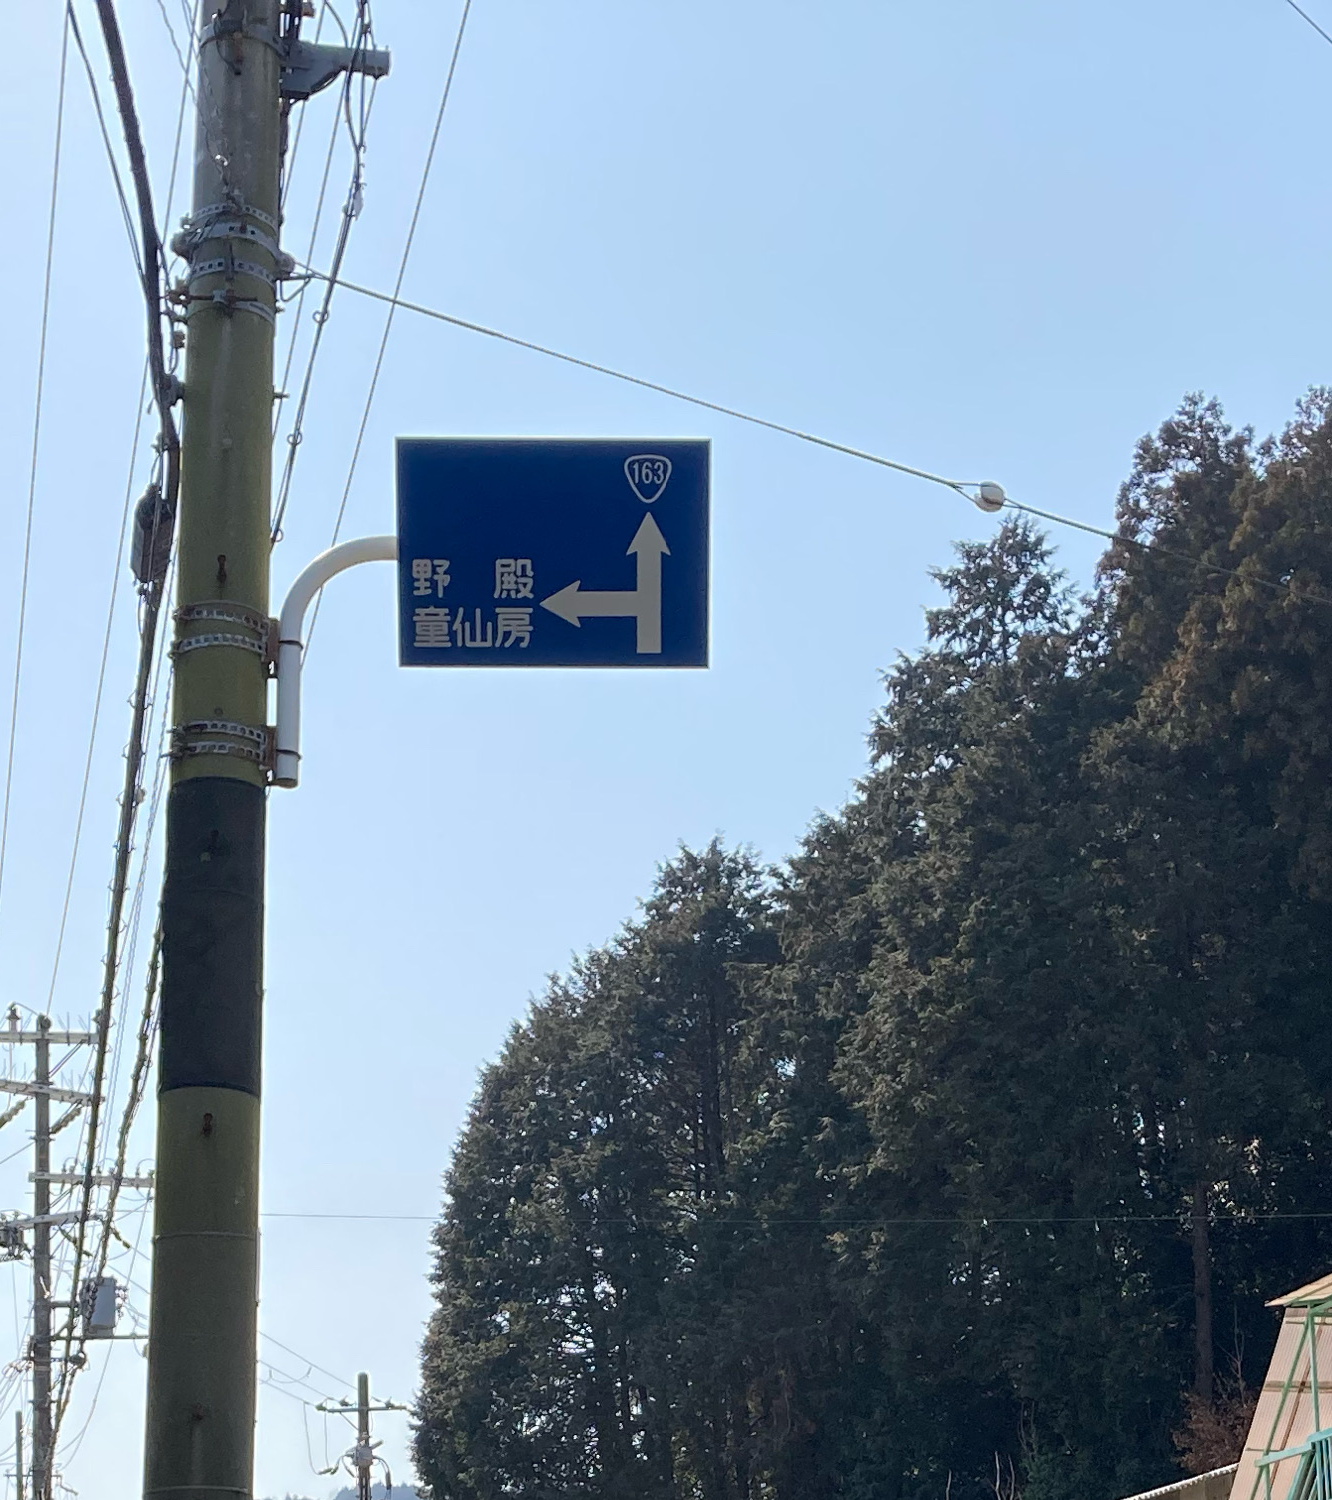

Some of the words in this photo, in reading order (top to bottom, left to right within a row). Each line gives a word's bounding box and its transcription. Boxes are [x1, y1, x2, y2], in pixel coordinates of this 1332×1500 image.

[632, 461, 664, 485] 163
[412, 605, 534, 649] 童仙房
